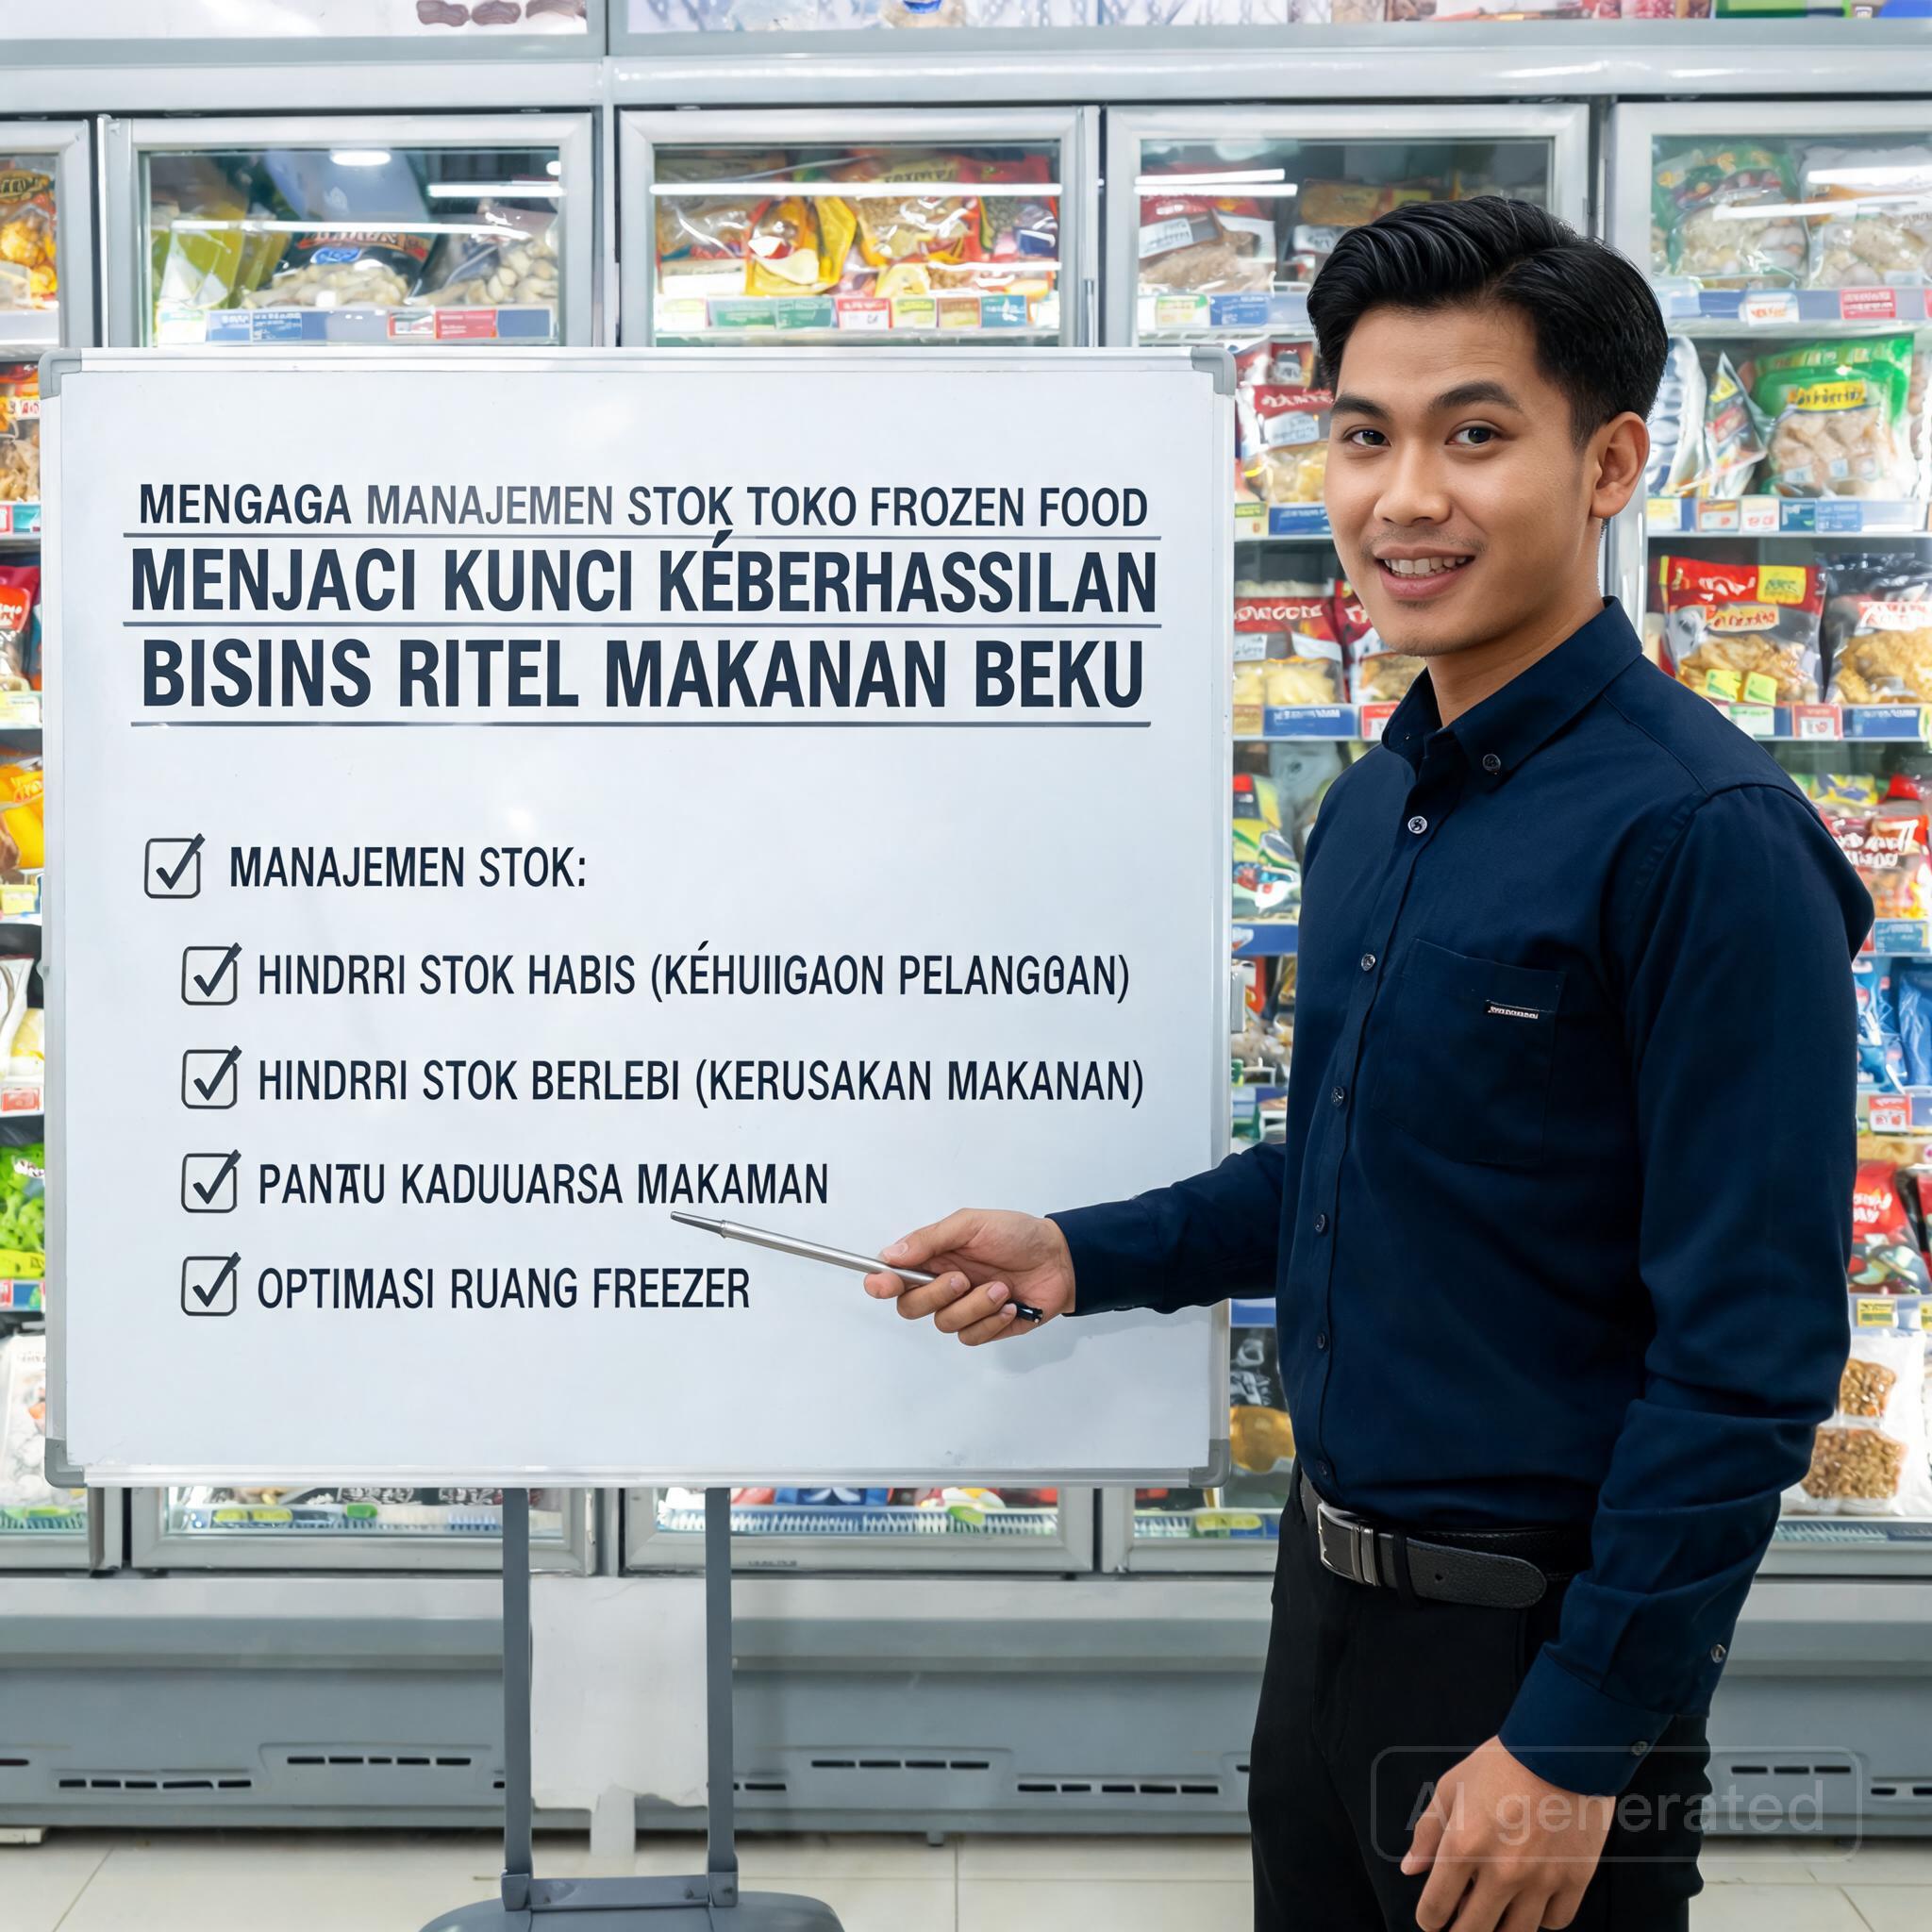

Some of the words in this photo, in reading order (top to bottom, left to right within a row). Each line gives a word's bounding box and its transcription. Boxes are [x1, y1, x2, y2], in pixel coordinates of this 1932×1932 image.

[140, 483, 352, 525] MENGAGA
[367, 485, 613, 525] MANAJEMEN
[627, 486, 734, 526] STOK
[746, 486, 857, 526] TOKO
[871, 487, 1024, 527] FROZEN
[1040, 487, 1148, 527] FOOD
[132, 548, 415, 612] MENJACI
[444, 549, 632, 612] KUNCI
[143, 639, 372, 708] BISINS
[399, 639, 579, 708] RITEL
[606, 640, 946, 708] MAKANAN
[975, 640, 1143, 708] BEKU
[230, 846, 464, 888] MANAJEMEN
[478, 846, 586, 888] STOK:
[258, 954, 406, 995] HINDRRI
[420, 954, 515, 995] STOK
[528, 954, 636, 995] HABIS
[259, 1059, 407, 1101] HINDRRI
[423, 1059, 518, 1101] STOK
[532, 1059, 679, 1101] BERLEBI
[695, 1058, 931, 1109] (KERUSAKAN
[948, 1059, 1143, 1109] MAKANAN)
[402, 1163, 624, 1205] KADUUARSA
[638, 1163, 828, 1205] MAKAMAN
[258, 1267, 434, 1309] OPTIMASI
[451, 1267, 577, 1309] RUANG
[593, 1267, 750, 1308] FREEZER
